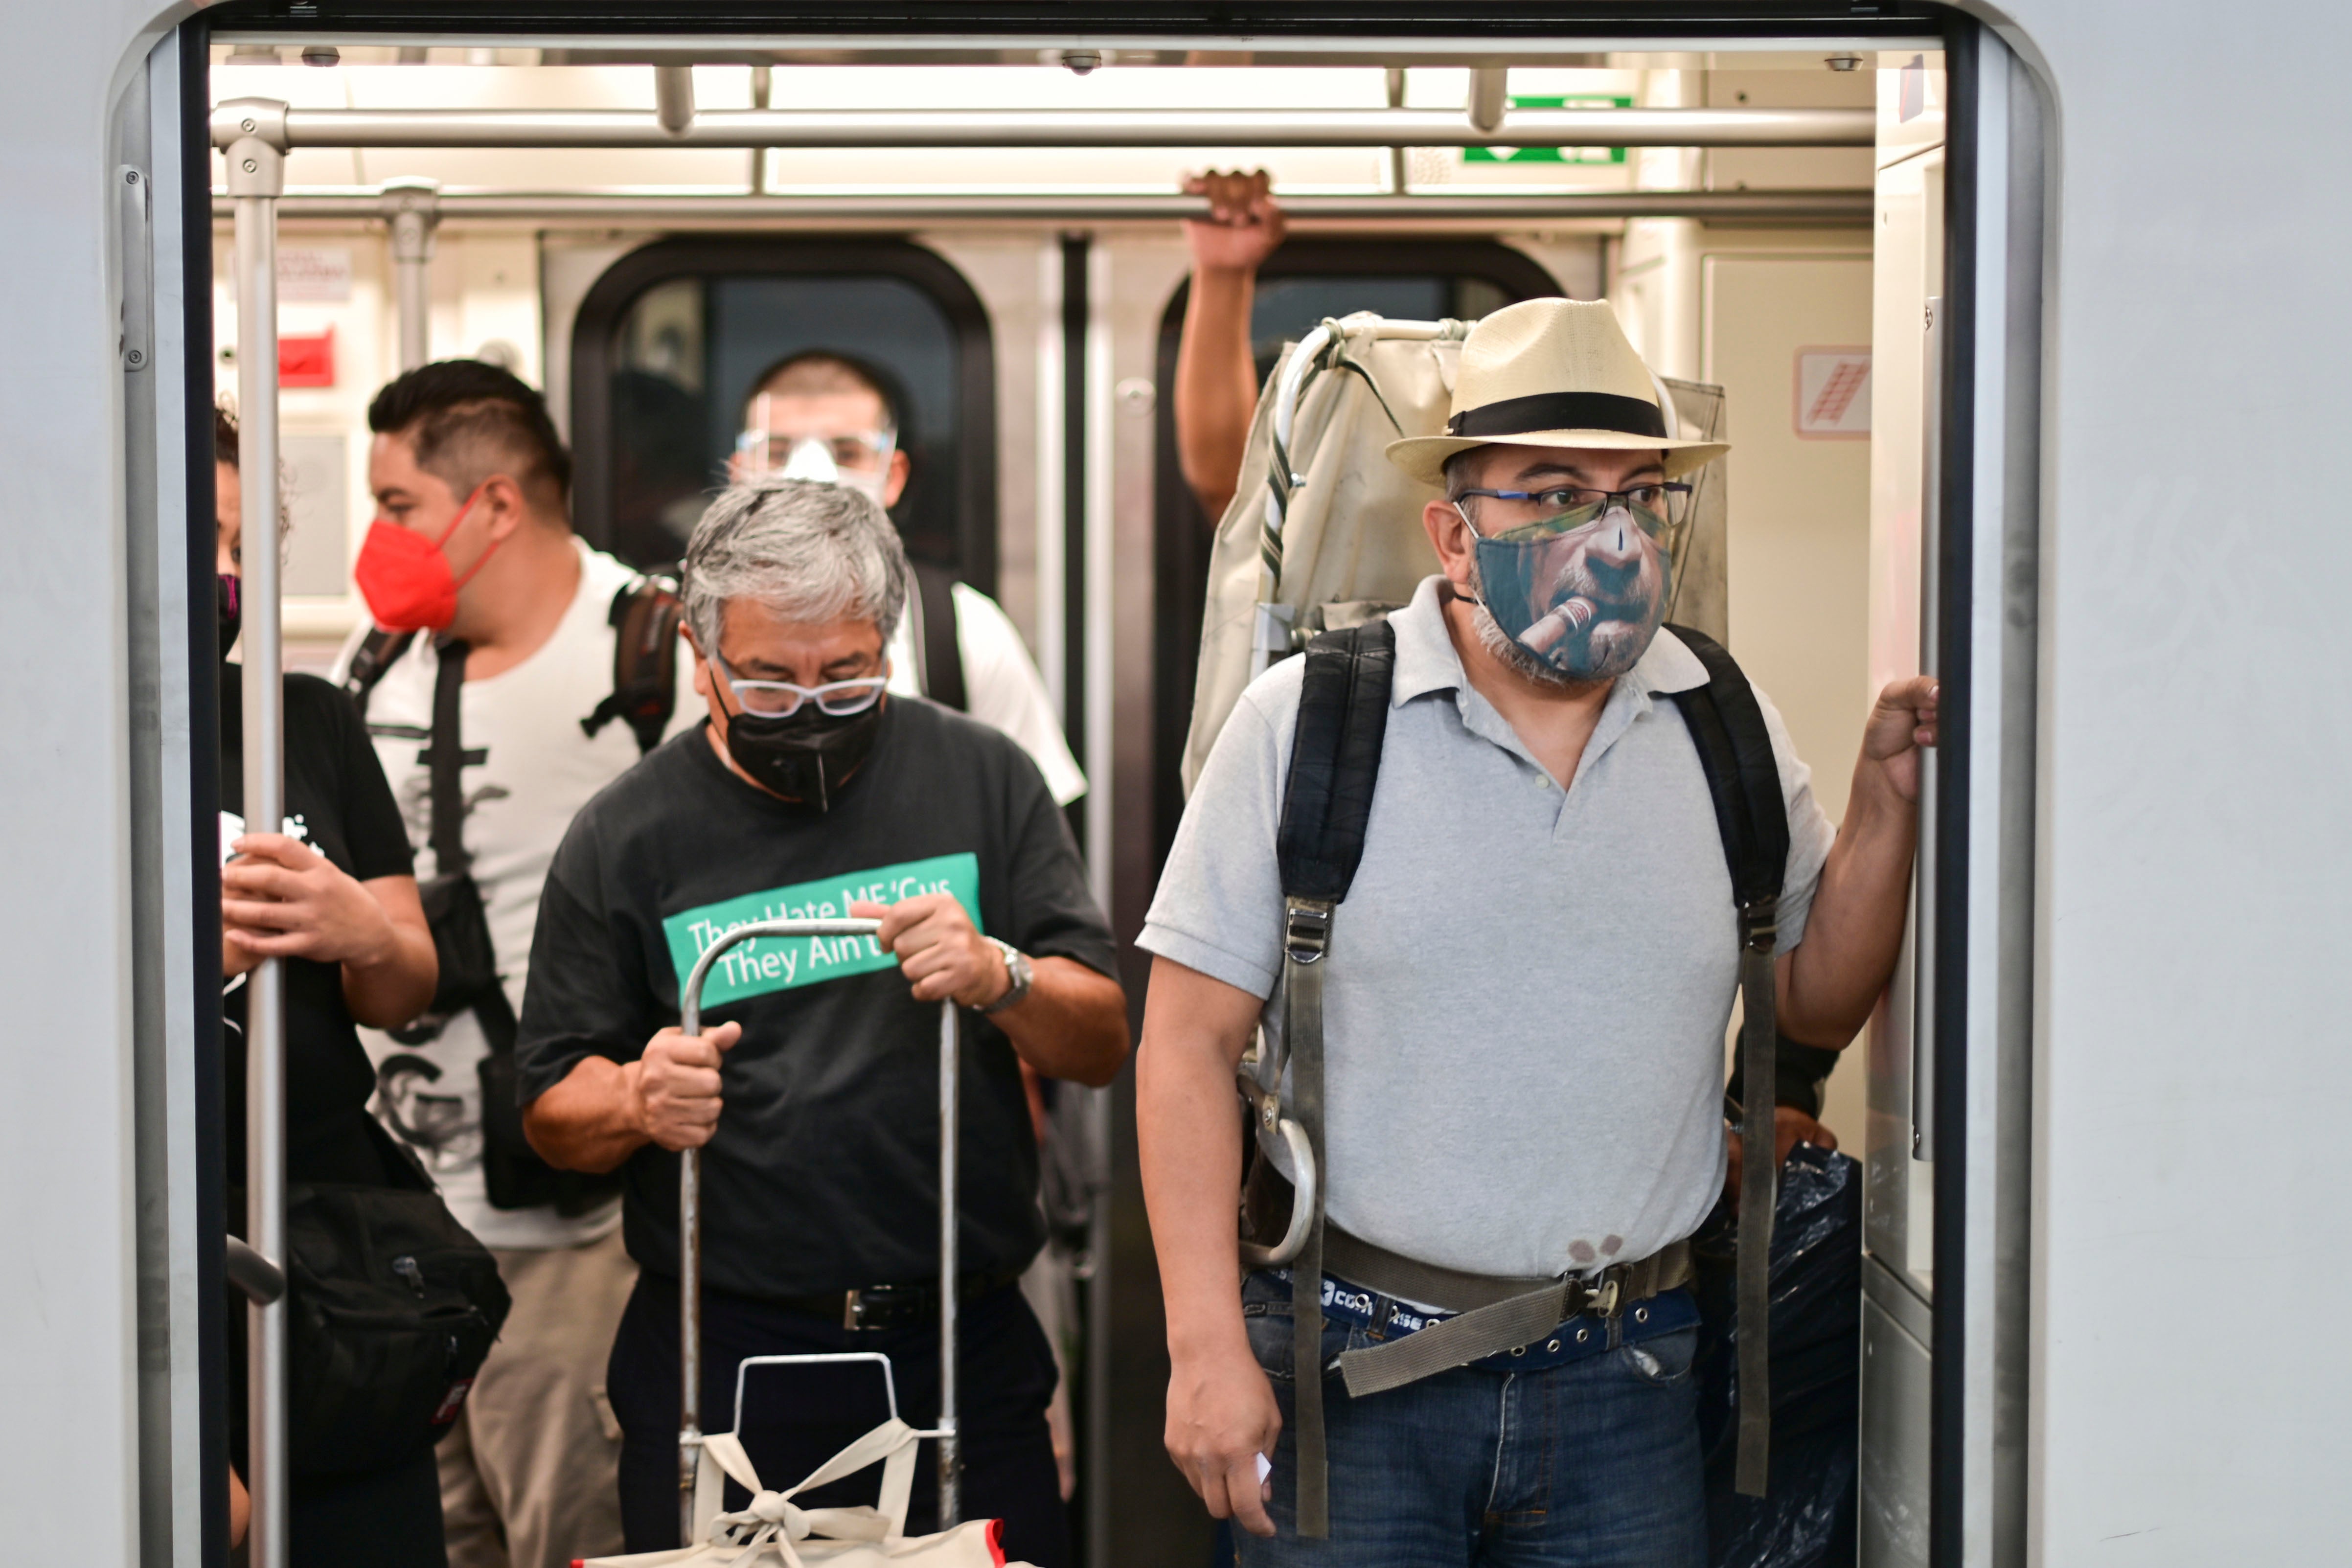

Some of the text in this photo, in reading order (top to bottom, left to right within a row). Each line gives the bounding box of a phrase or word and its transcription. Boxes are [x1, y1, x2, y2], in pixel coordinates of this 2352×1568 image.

[764, 901, 836, 921] Hate
[717, 934, 881, 986] They Aint
